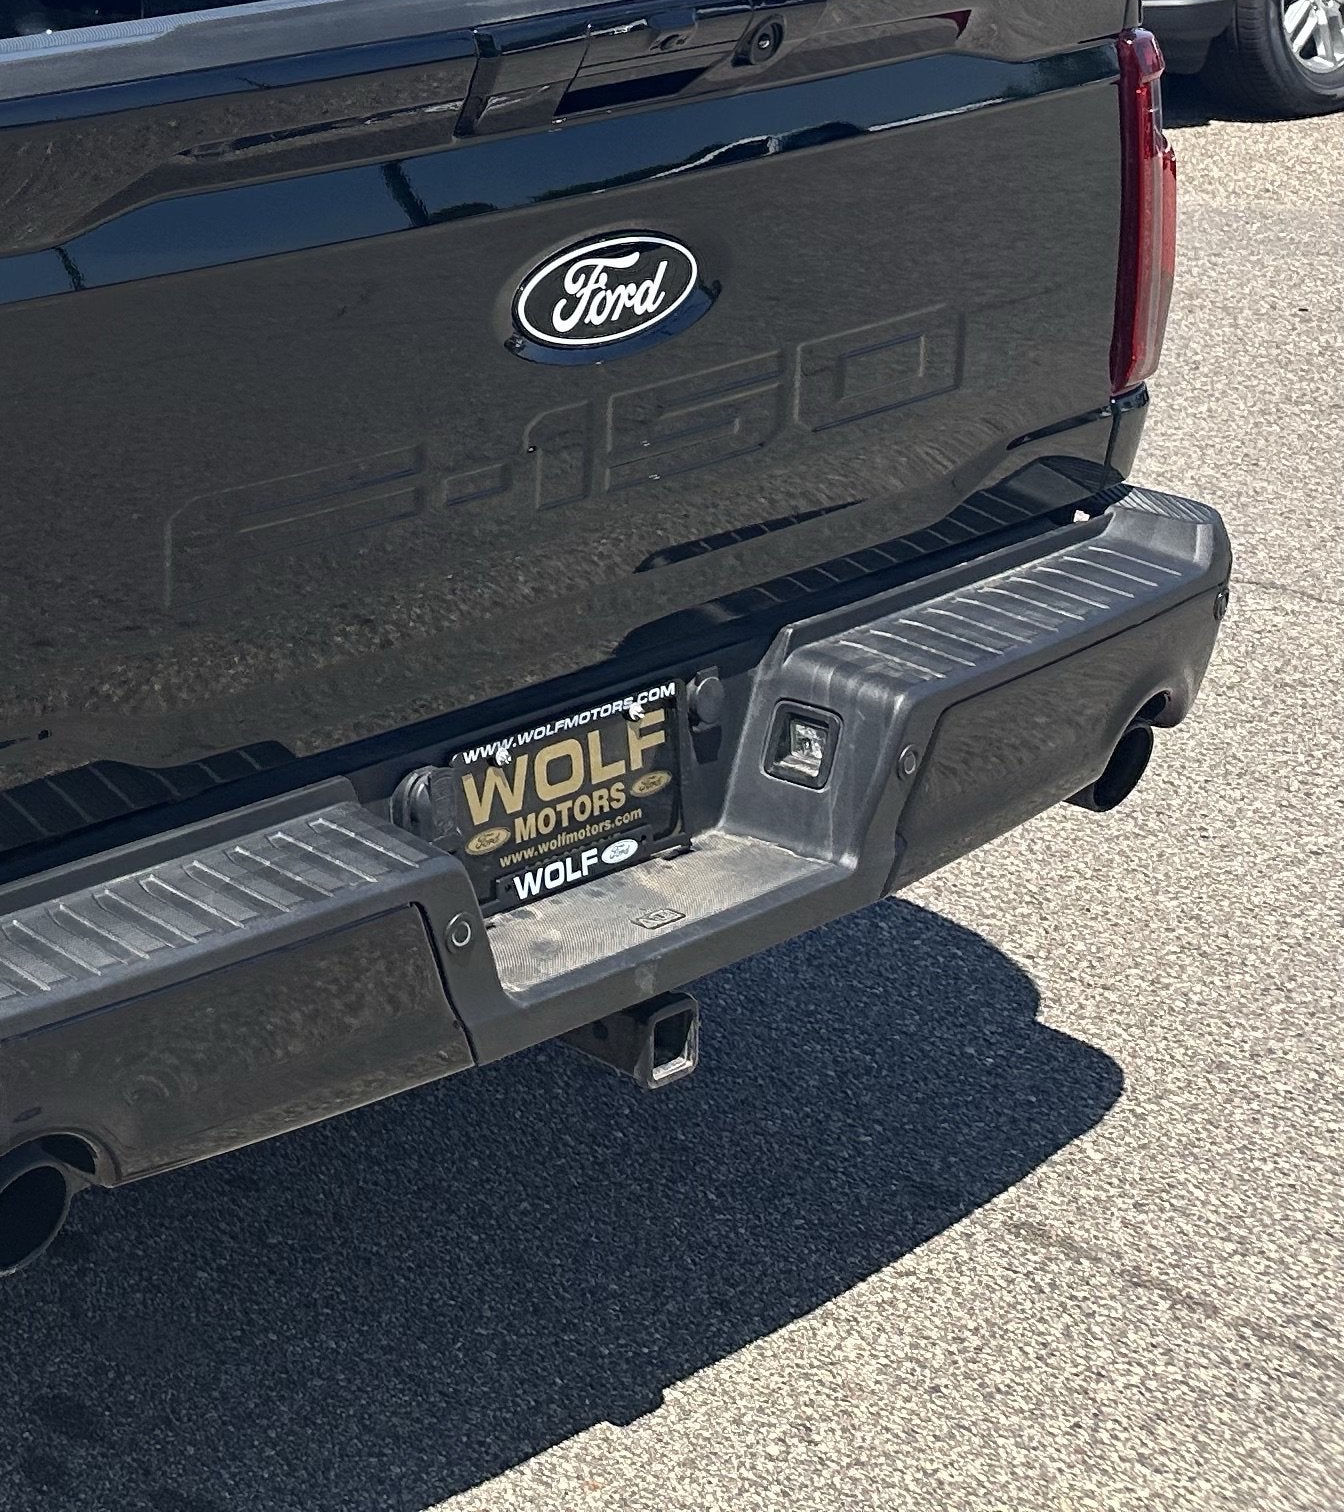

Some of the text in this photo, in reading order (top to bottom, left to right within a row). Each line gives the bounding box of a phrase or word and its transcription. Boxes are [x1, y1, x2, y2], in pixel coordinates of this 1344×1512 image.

[552, 251, 668, 333] Ford
[463, 682, 676, 765] WWW.WOLFMOTORSCOM
[461, 708, 666, 825] WOLF
[499, 806, 643, 868] www.wolfmotors.com
[514, 781, 626, 844] MOTORS
[513, 847, 599, 900] WOLF
